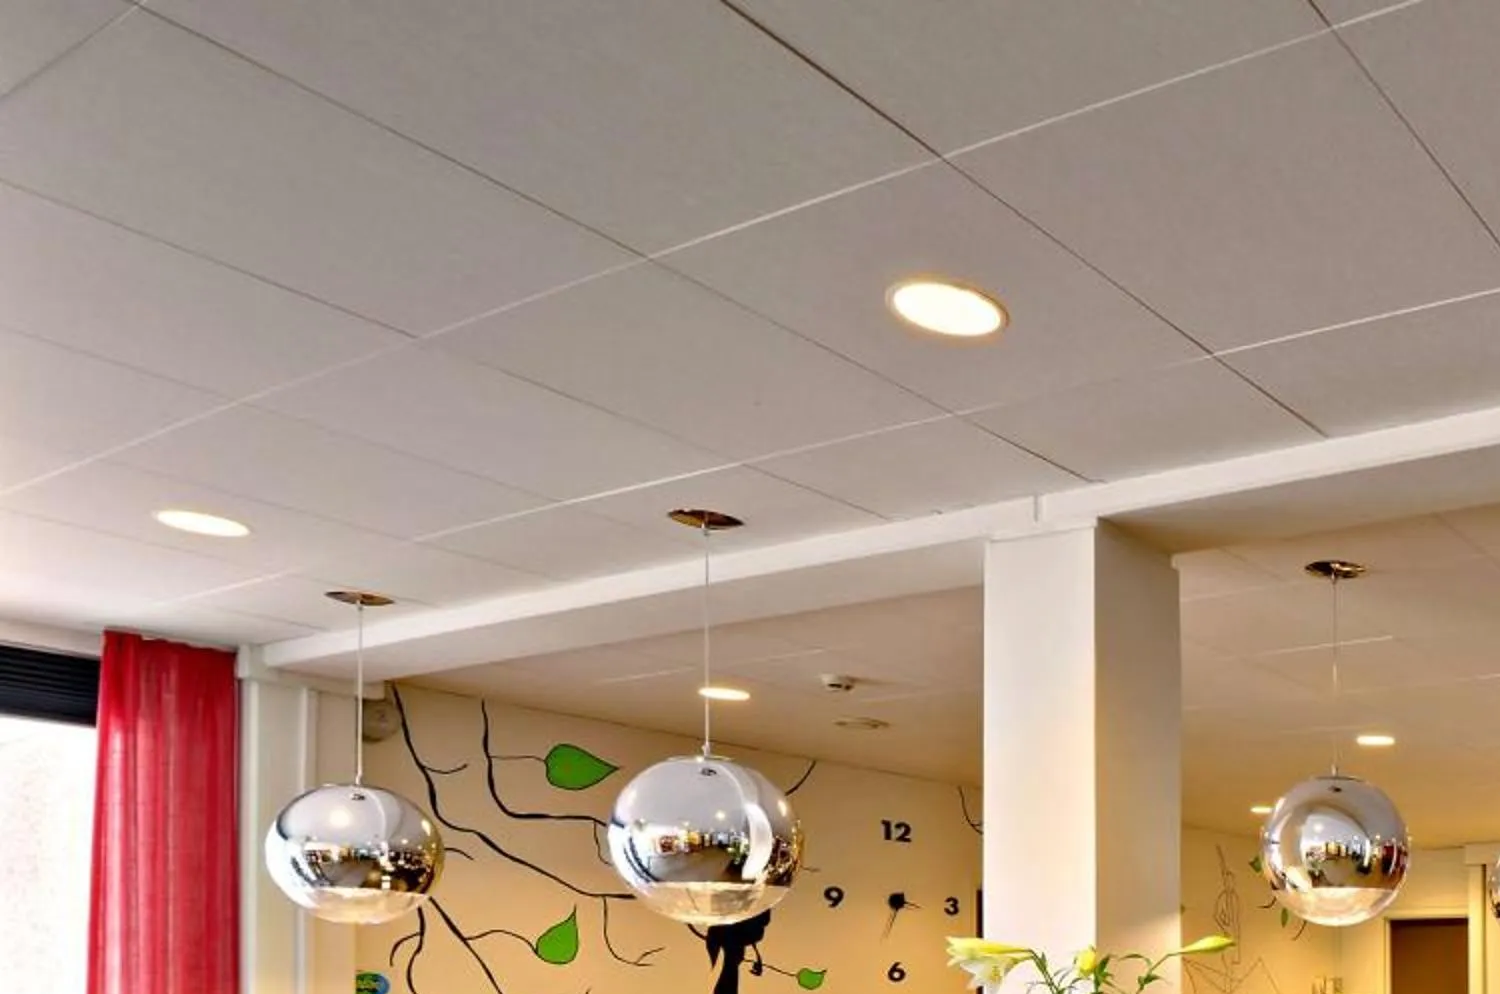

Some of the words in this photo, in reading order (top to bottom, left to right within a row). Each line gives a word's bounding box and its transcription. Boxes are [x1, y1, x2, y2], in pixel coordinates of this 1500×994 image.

[881, 819, 912, 843] 12
[823, 886, 845, 908] 9
[944, 896, 960, 916] 3
[887, 962, 906, 982] 6
